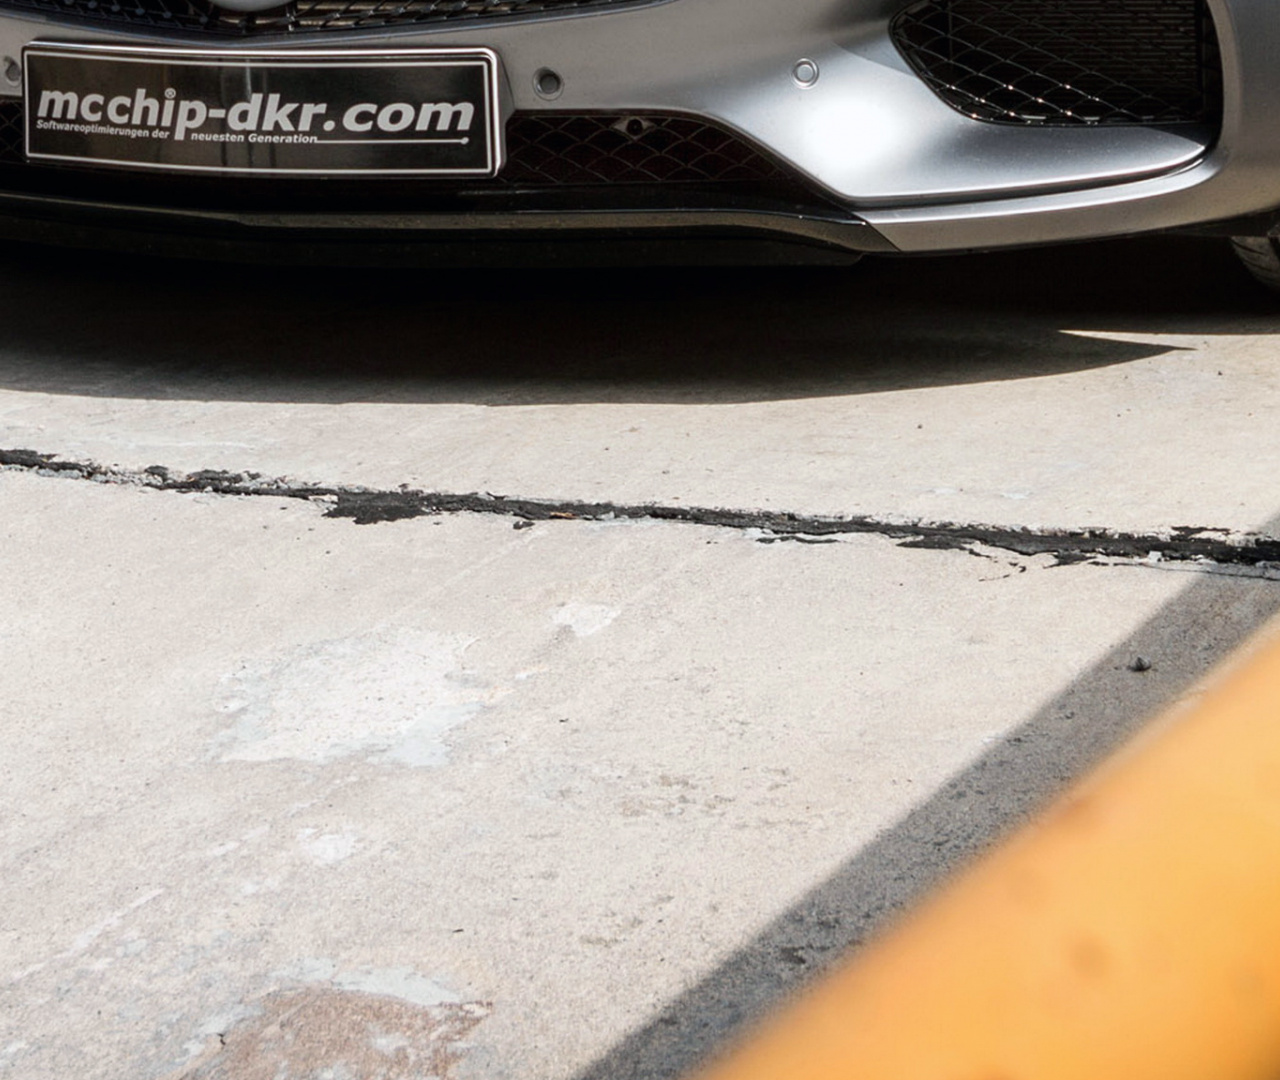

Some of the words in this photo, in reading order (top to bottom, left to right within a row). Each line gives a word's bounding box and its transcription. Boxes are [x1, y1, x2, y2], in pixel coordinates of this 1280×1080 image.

[36, 87, 475, 141] mcchip-dkr.com
[36, 119, 149, 138] Softwareoptimierungen
[151, 128, 170, 140] der
[190, 132, 245, 143] neuesten
[248, 133, 318, 144] Generation
